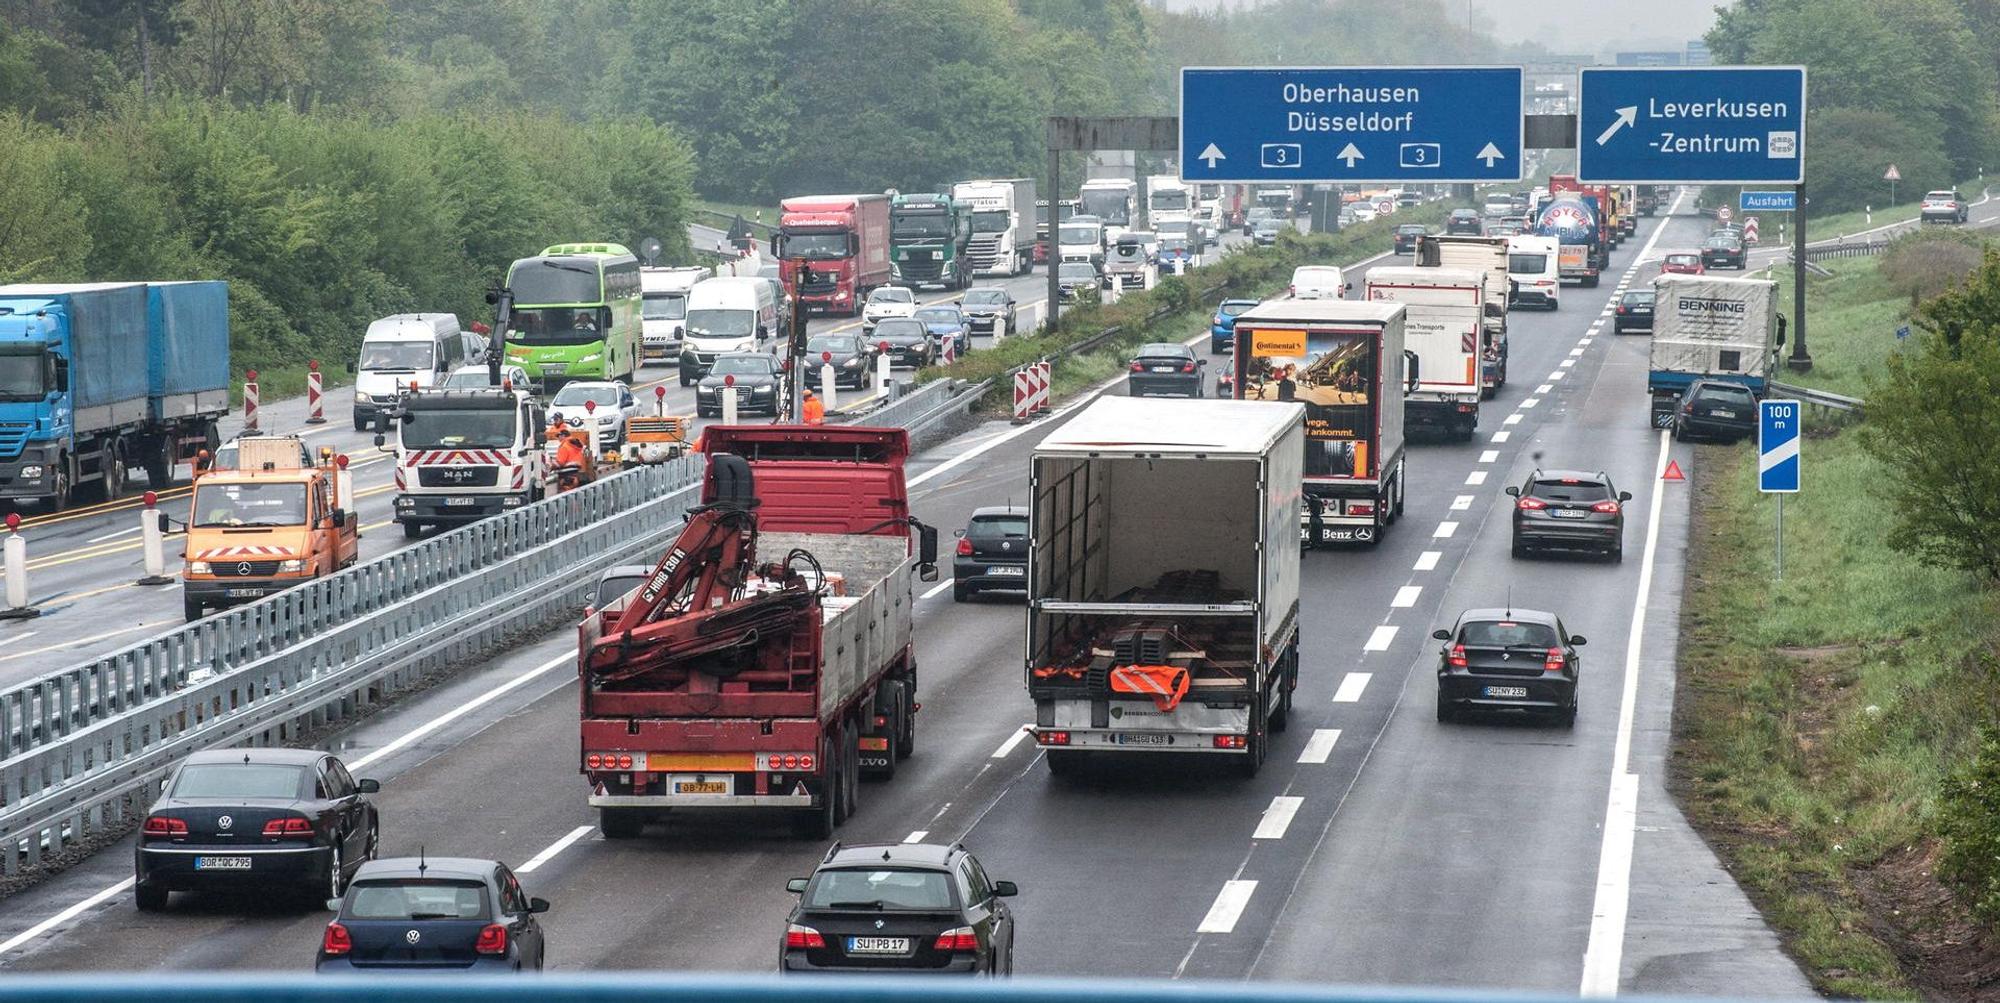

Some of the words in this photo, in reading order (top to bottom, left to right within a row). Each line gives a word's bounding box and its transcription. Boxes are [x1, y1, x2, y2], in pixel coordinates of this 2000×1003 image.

[1283, 83, 1419, 103] Oberhausen
[1650, 97, 1787, 118] Leverkusen
[1288, 111, 1413, 132] Düsseldorf
[1649, 132, 1760, 153] -Zentrum
[1277, 149, 1286, 163] 3
[1415, 148, 1425, 163] 3
[1747, 196, 1793, 207] Ausfahrt
[1543, 206, 1589, 226] HOYER
[1679, 300, 1745, 314] BENNING
[1417, 322, 1445, 331] Transporte
[1256, 341, 1296, 351] Continental
[1769, 405, 1791, 418] 100
[1774, 420, 1786, 429] m
[1311, 428, 1355, 437] ankommt.
[443, 470, 473, 479] MAN
[1322, 528, 1352, 540] Benz
[649, 571, 669, 593] HIAB
[663, 554, 680, 573] 130
[674, 547, 686, 559] R
[857, 758, 888, 767] LVO
[857, 938, 870, 949] SU
[876, 939, 890, 950] PB
[891, 939, 905, 950] 17
